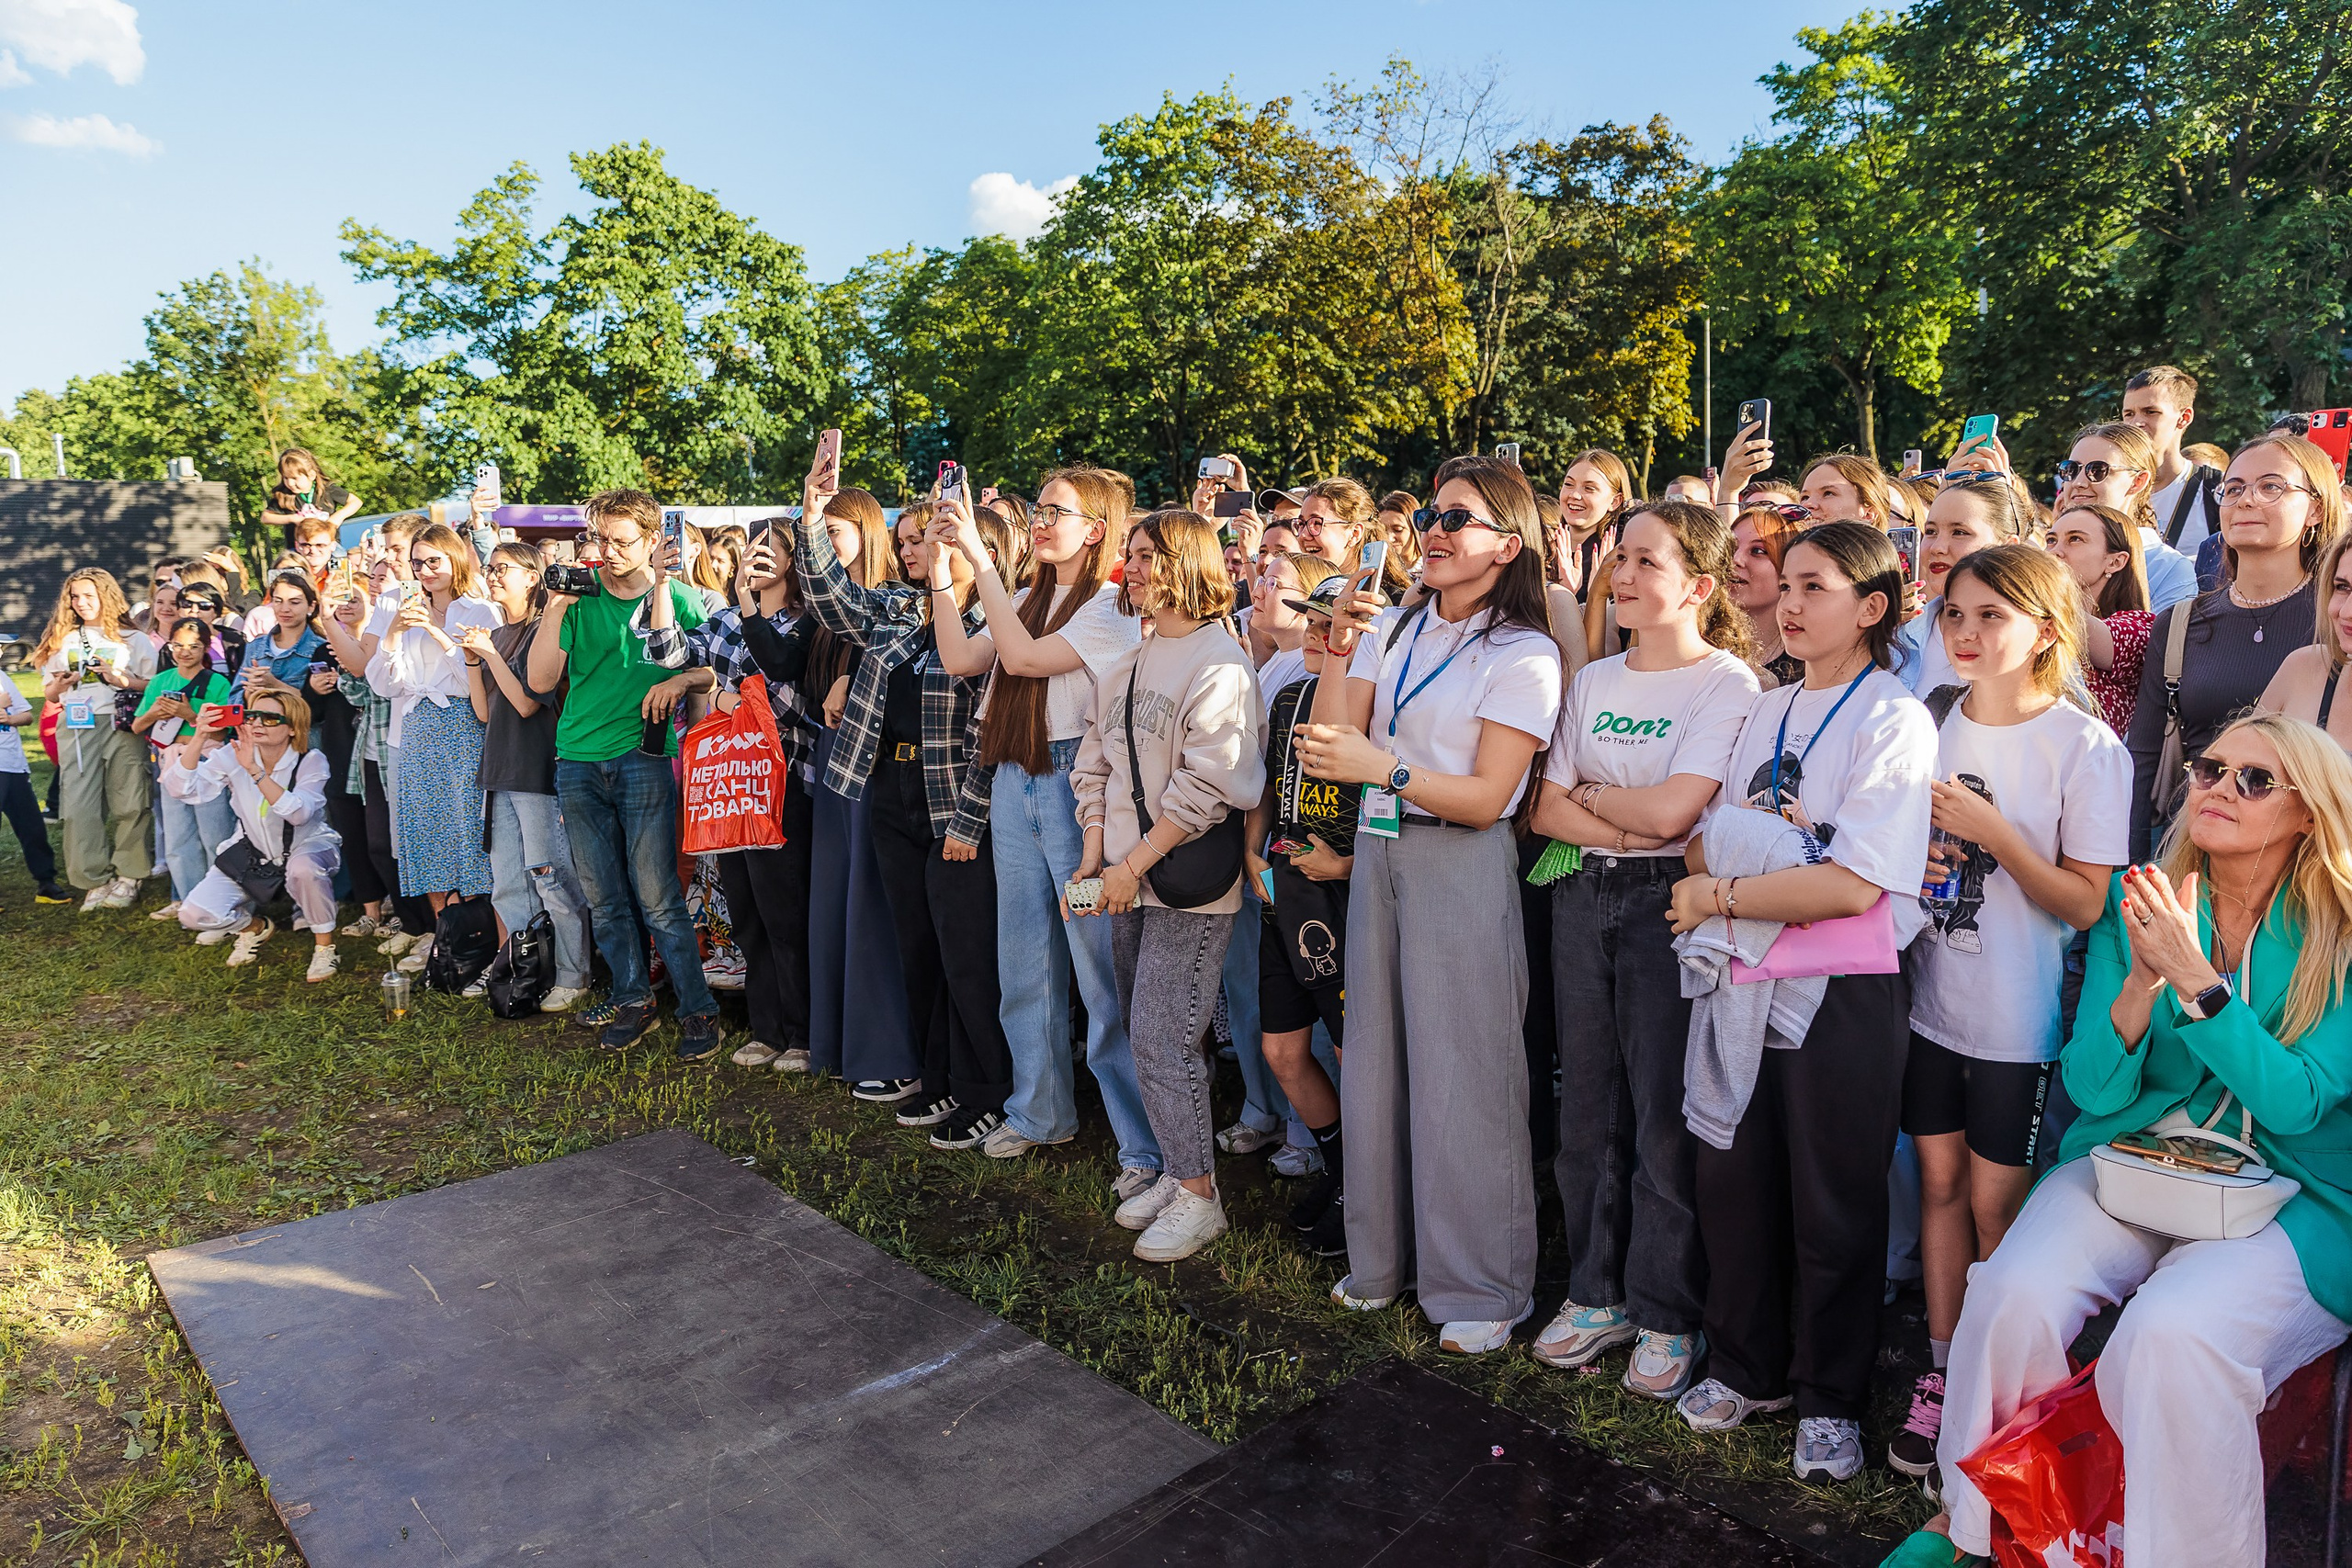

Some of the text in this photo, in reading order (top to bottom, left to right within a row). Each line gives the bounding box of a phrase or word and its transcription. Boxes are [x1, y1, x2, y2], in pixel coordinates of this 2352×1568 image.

[1591, 711, 1672, 739] Don't
[688, 797, 770, 822] ТОВАРЫ
[2035, 1076, 2048, 1111] GET
[2025, 1115, 2041, 1166] START
